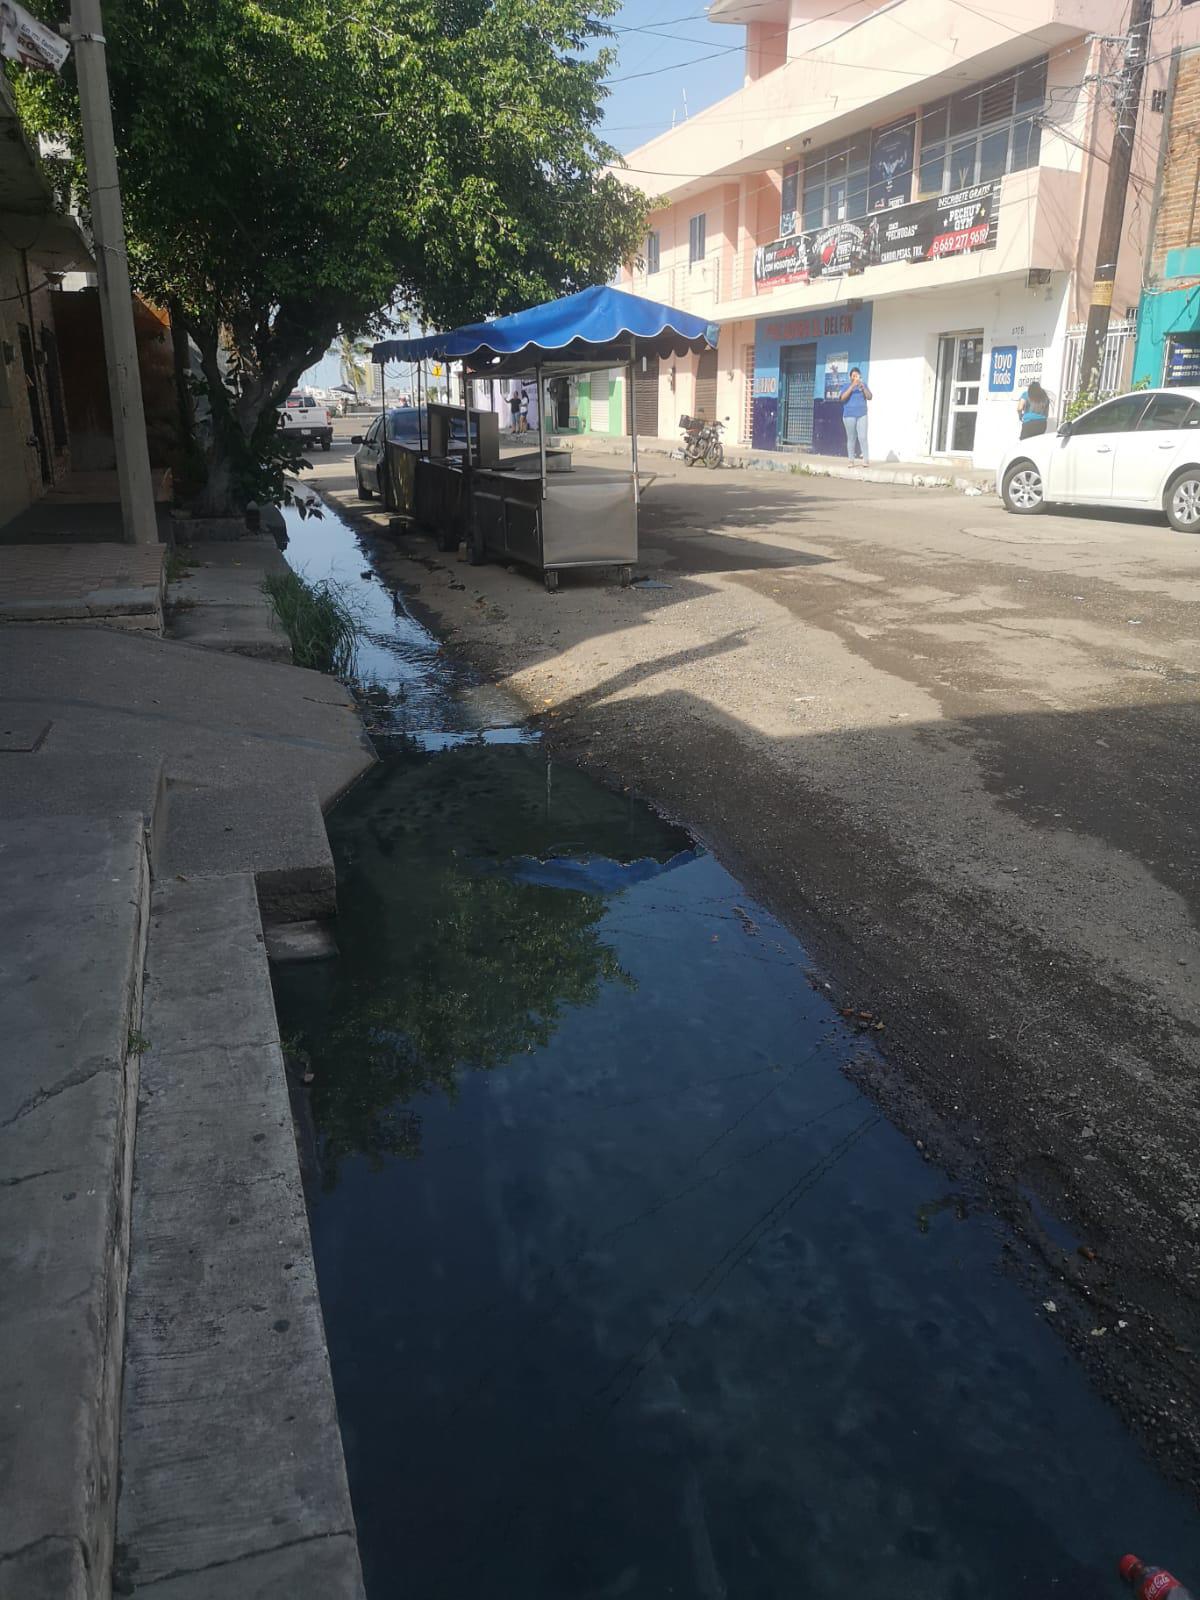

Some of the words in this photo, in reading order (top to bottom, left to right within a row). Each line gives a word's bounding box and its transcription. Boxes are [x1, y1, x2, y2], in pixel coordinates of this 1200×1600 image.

[954, 216, 974, 231] GYM
[939, 237, 954, 251] 669
[955, 233, 969, 249] 277
[1035, 348, 1044, 358] en
[994, 351, 1013, 372] toyo
[1019, 362, 1043, 374] comida
[992, 369, 1012, 385] foods
